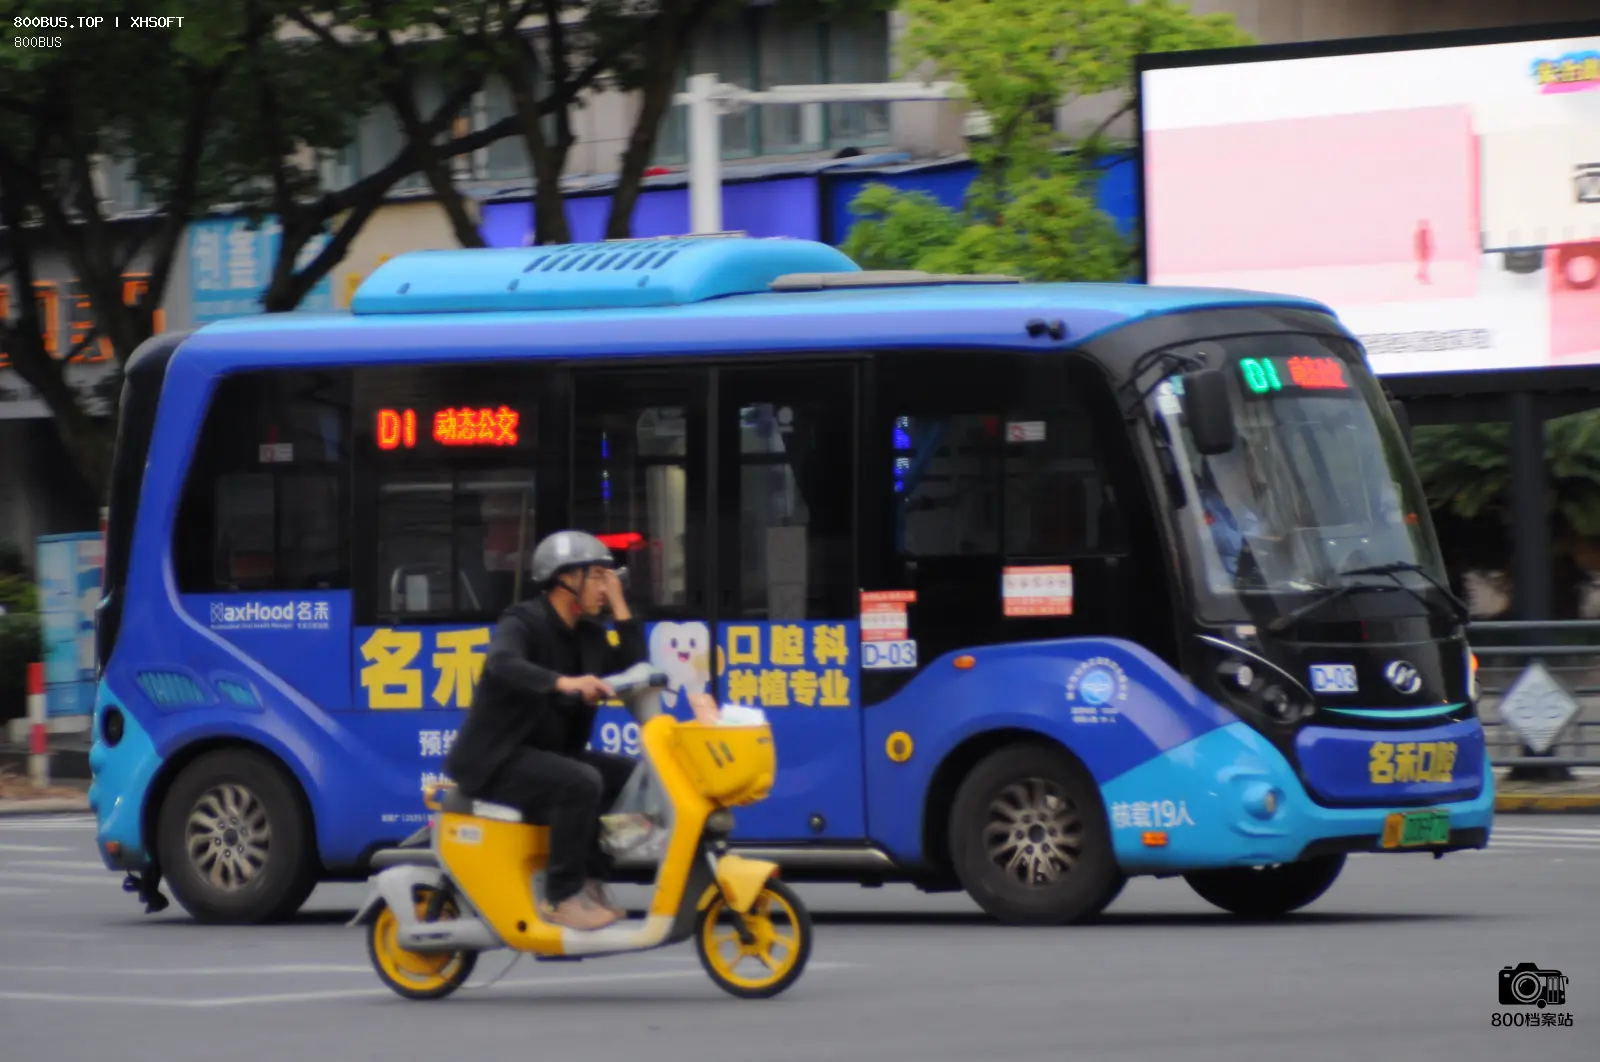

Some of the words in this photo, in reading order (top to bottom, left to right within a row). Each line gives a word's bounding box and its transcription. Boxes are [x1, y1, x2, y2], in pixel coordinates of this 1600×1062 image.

[433, 405, 519, 446] 动态公交
[297, 601, 329, 621] 名禾
[727, 624, 849, 666] 口腔科
[862, 643, 916, 666] D-03
[727, 668, 849, 707] 种植专业
[1311, 667, 1357, 689] D-03
[1368, 741, 1457, 784] 名禾口腔
